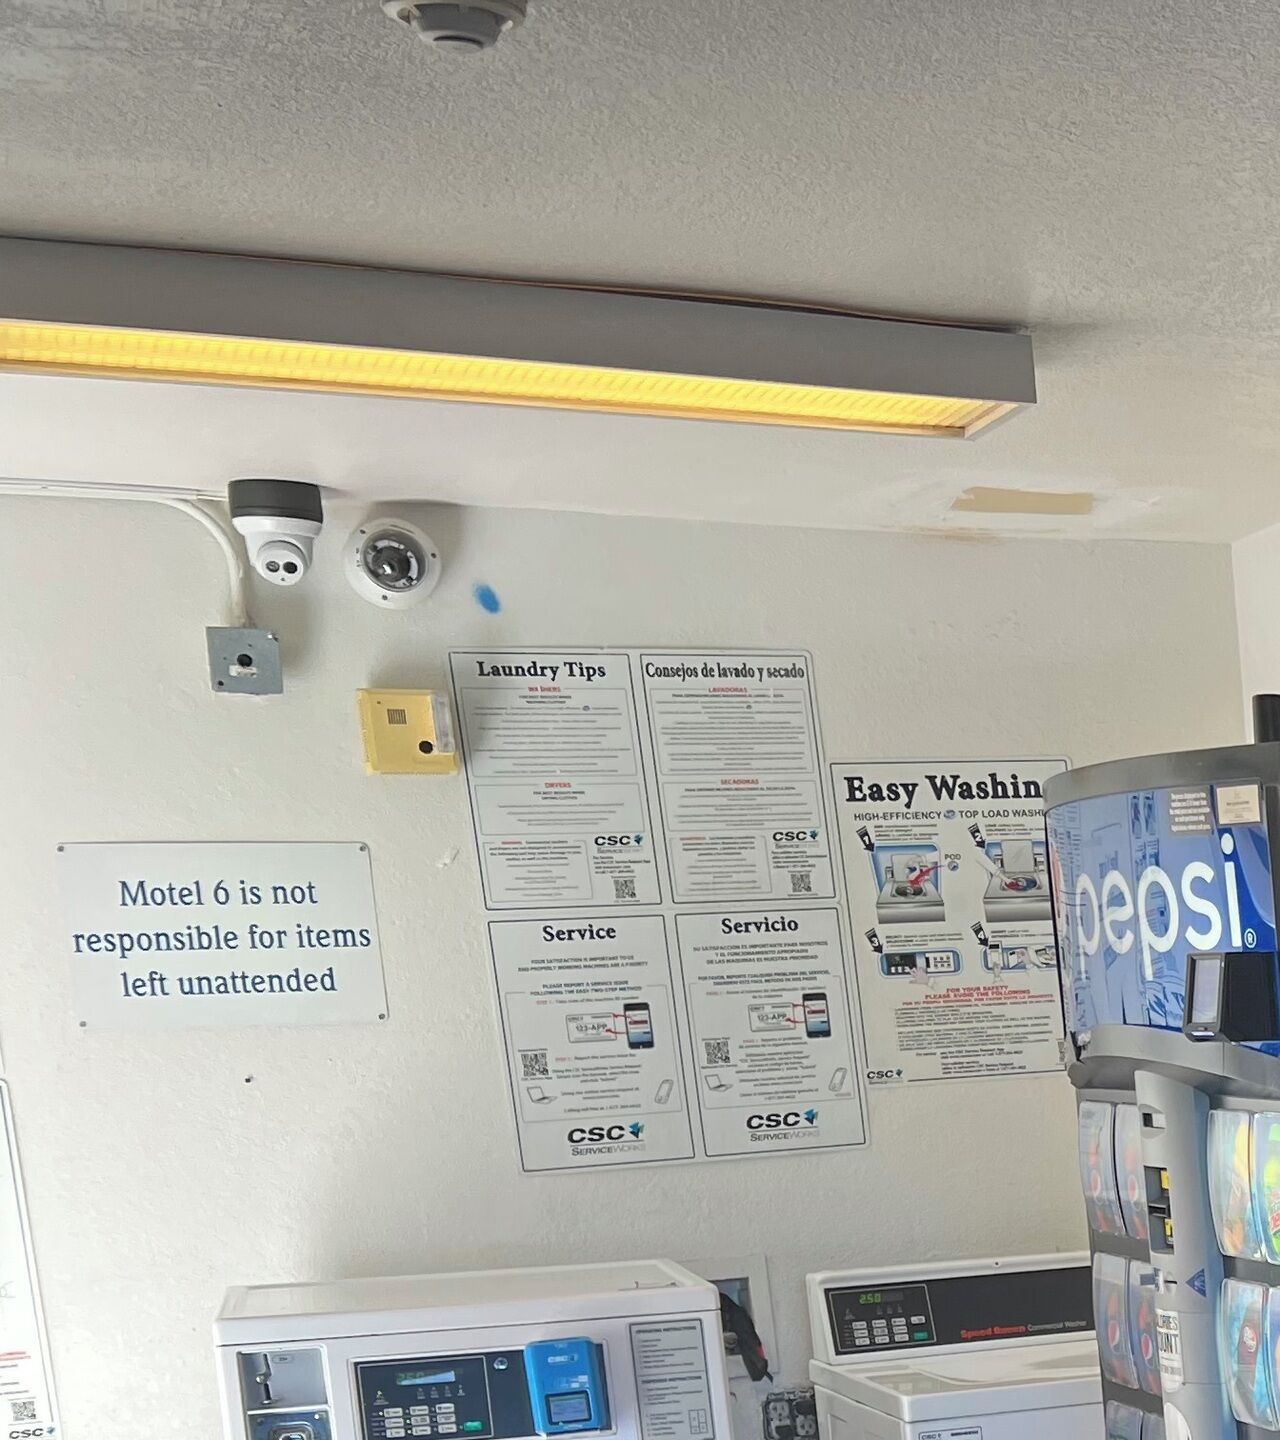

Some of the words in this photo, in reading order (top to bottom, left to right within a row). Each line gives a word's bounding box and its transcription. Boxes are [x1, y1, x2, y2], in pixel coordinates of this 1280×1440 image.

[476, 660, 560, 682] Laundry
[563, 661, 607, 682] Tips
[645, 662, 699, 682] Consejos
[701, 662, 715, 678] de
[716, 662, 755, 678] lavado
[757, 667, 765, 682] y
[766, 663, 805, 678] secado
[843, 776, 919, 809] Easy
[925, 772, 1043, 801] Washin
[853, 811, 942, 821] HIGH-EFFICIENCY
[959, 810, 981, 819] TOP
[982, 809, 1010, 819] LOAD
[594, 835, 631, 847] CSC
[772, 831, 807, 842] CSC
[944, 853, 961, 861] POD
[119, 880, 205, 907] Motel
[213, 879, 230, 906] 6
[240, 880, 262, 905] is
[272, 881, 319, 905] not
[1075, 832, 1242, 983] pepsi
[542, 924, 617, 942] Service
[721, 916, 799, 935] Servicio
[73, 925, 239, 959] responsible
[248, 924, 288, 949] for
[295, 923, 372, 949] items
[120, 971, 170, 997] left
[176, 967, 338, 996] unattended
[866, 1070, 894, 1080] CSC
[746, 1112, 800, 1129] CSC
[568, 1125, 625, 1144] CSC
[859, 1293, 881, 1304] 250
[960, 1326, 991, 1338] Speed
[1065, 1320, 1088, 1329] Washer
[8, 1427, 44, 1439] CSC
